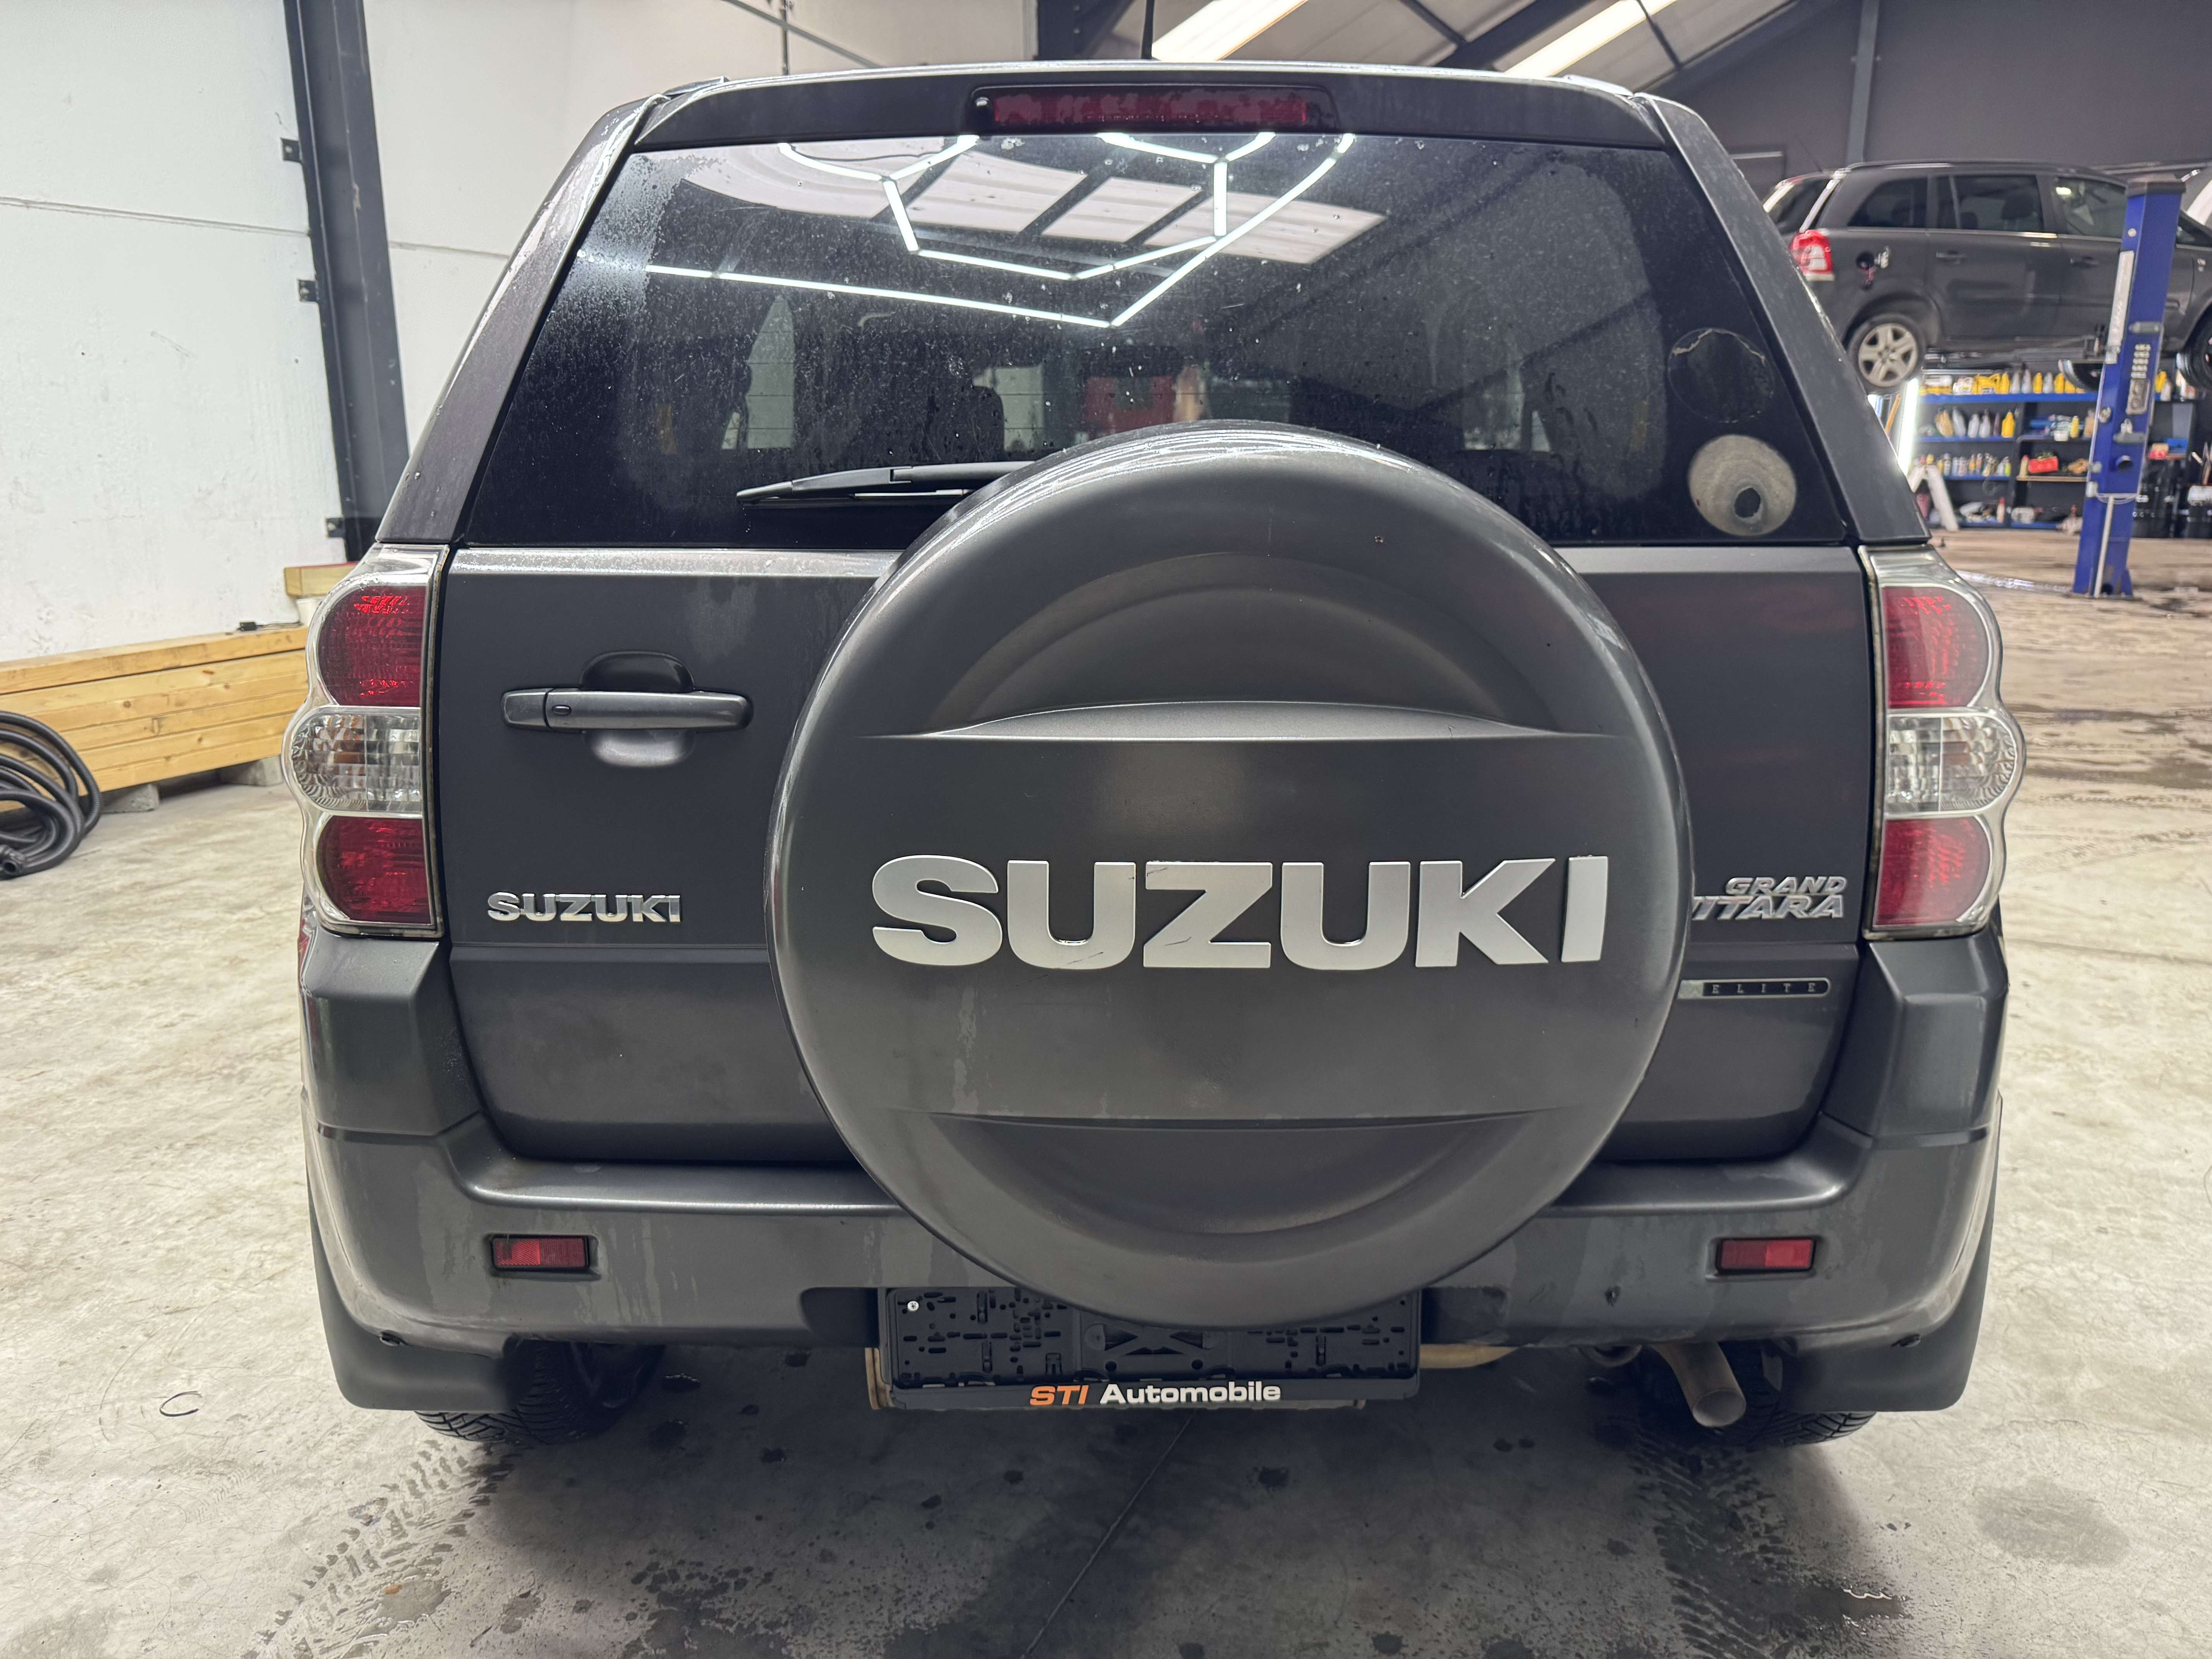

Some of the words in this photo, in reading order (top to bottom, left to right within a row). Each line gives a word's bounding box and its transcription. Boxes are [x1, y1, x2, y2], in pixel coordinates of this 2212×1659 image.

[1725, 876, 1847, 895] GRAND
[487, 892, 681, 922] SUZUKI
[872, 854, 1609, 970] SUZUKI
[1712, 982, 1816, 994] ELITE
[1030, 1385, 1089, 1405] STI
[1100, 1381, 1281, 1405] Automobile
